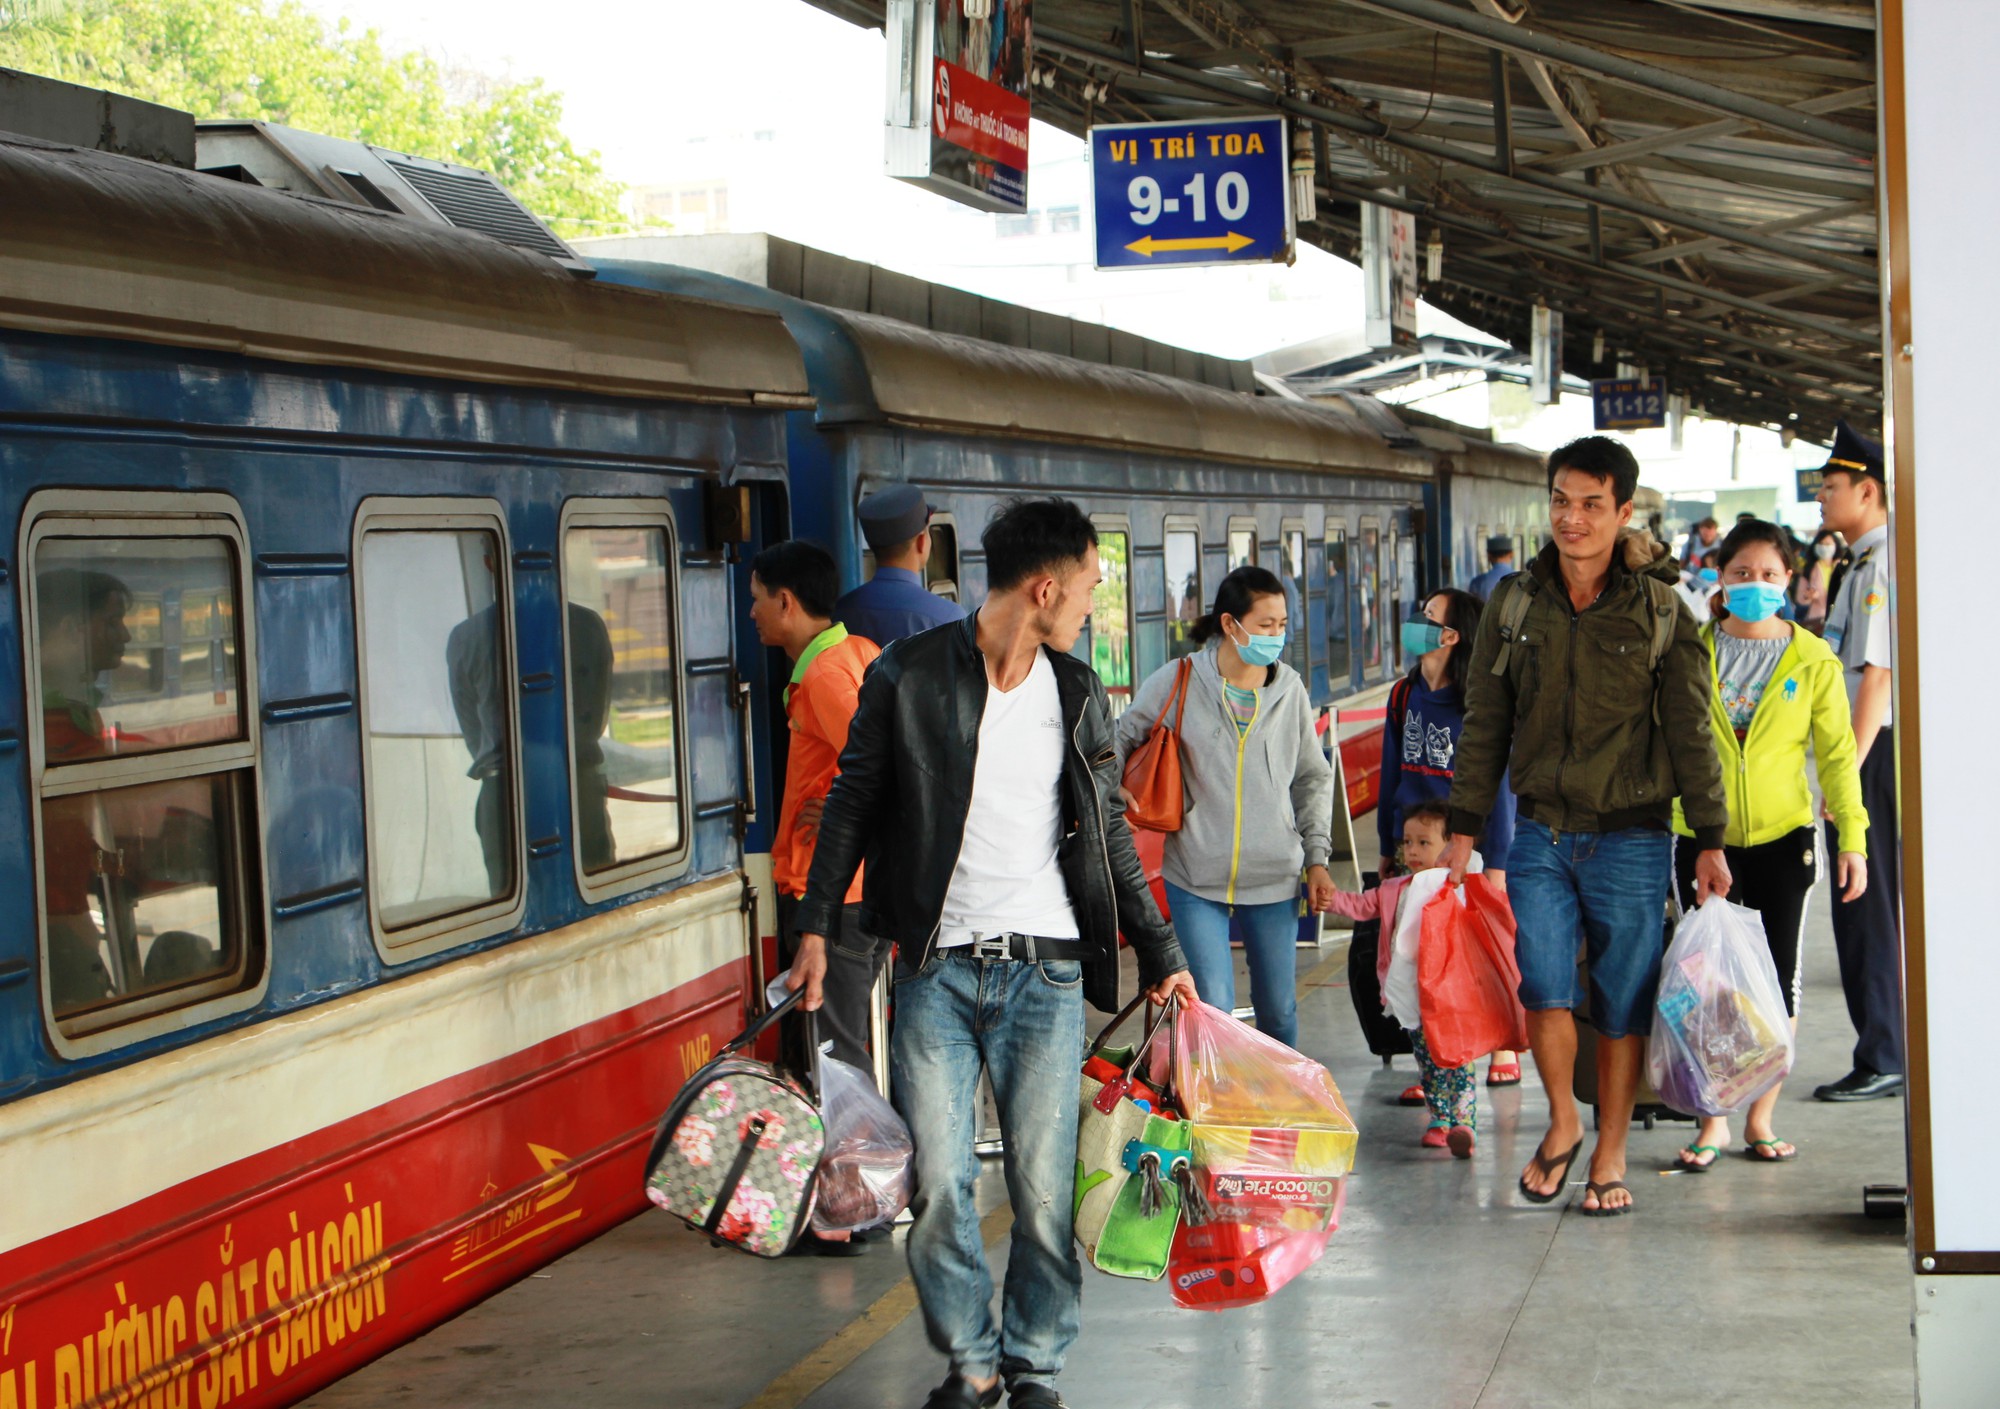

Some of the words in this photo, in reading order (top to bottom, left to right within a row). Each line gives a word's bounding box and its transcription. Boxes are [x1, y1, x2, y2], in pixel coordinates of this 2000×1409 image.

[1109, 140, 1138, 164] VỊ
[1150, 132, 1195, 159] TRÍ
[1206, 133, 1264, 157] TOA
[1127, 171, 1250, 225] 9-10
[1601, 395, 1660, 416] 11-12
[680, 1033, 710, 1080] VNR
[1177, 1267, 1217, 1290] OREO
[196, 1223, 262, 1409] SẮT
